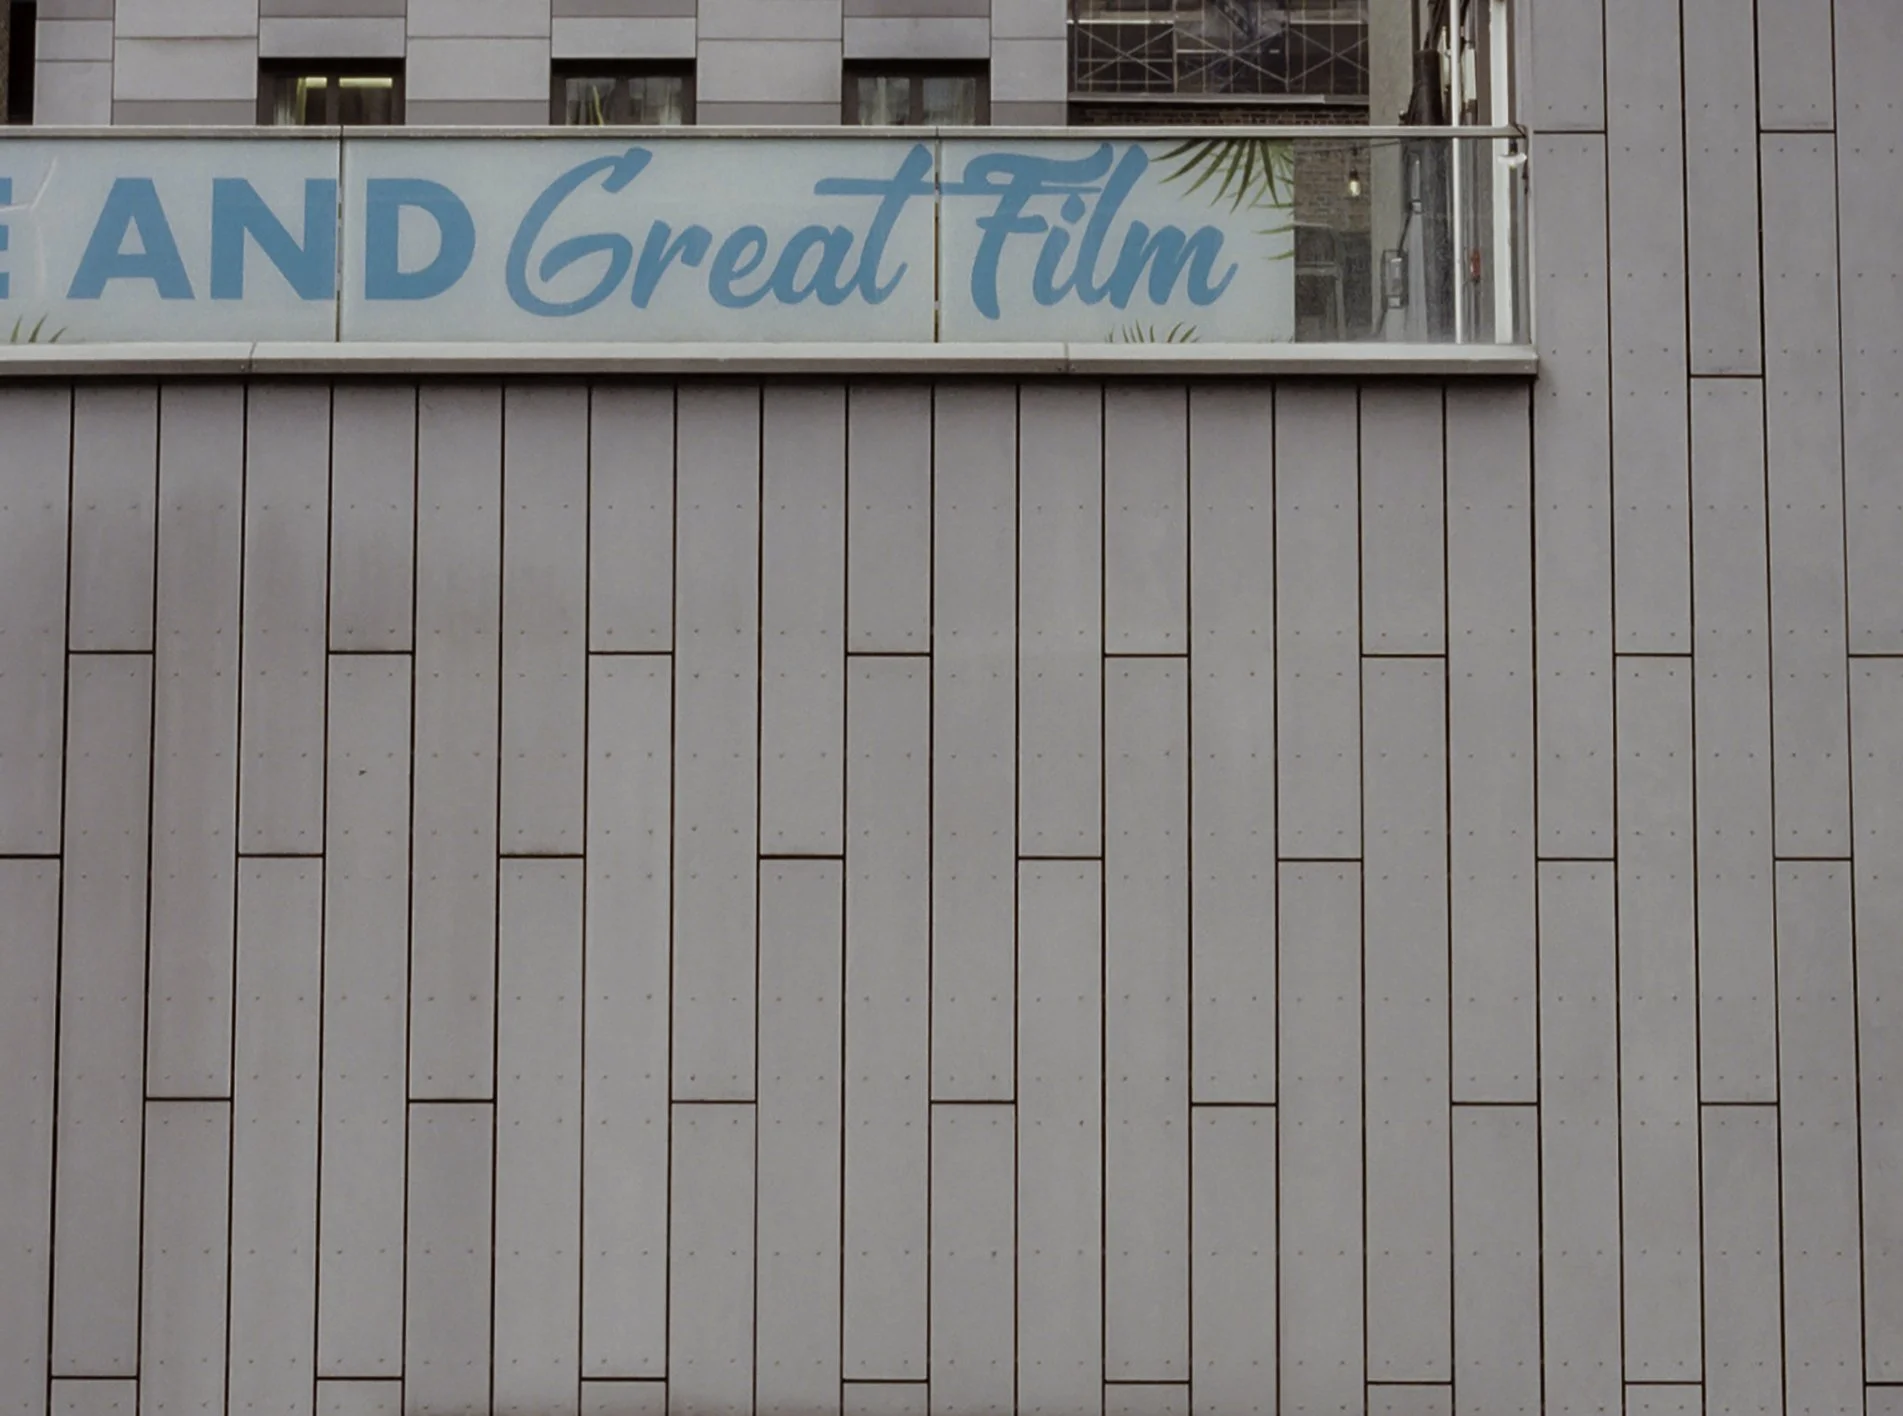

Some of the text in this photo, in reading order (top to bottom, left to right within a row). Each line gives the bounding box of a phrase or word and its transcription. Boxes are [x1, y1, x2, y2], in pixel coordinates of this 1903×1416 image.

[67, 176, 476, 302] AND
[505, 144, 934, 319] Great
[938, 143, 1239, 321] Film
